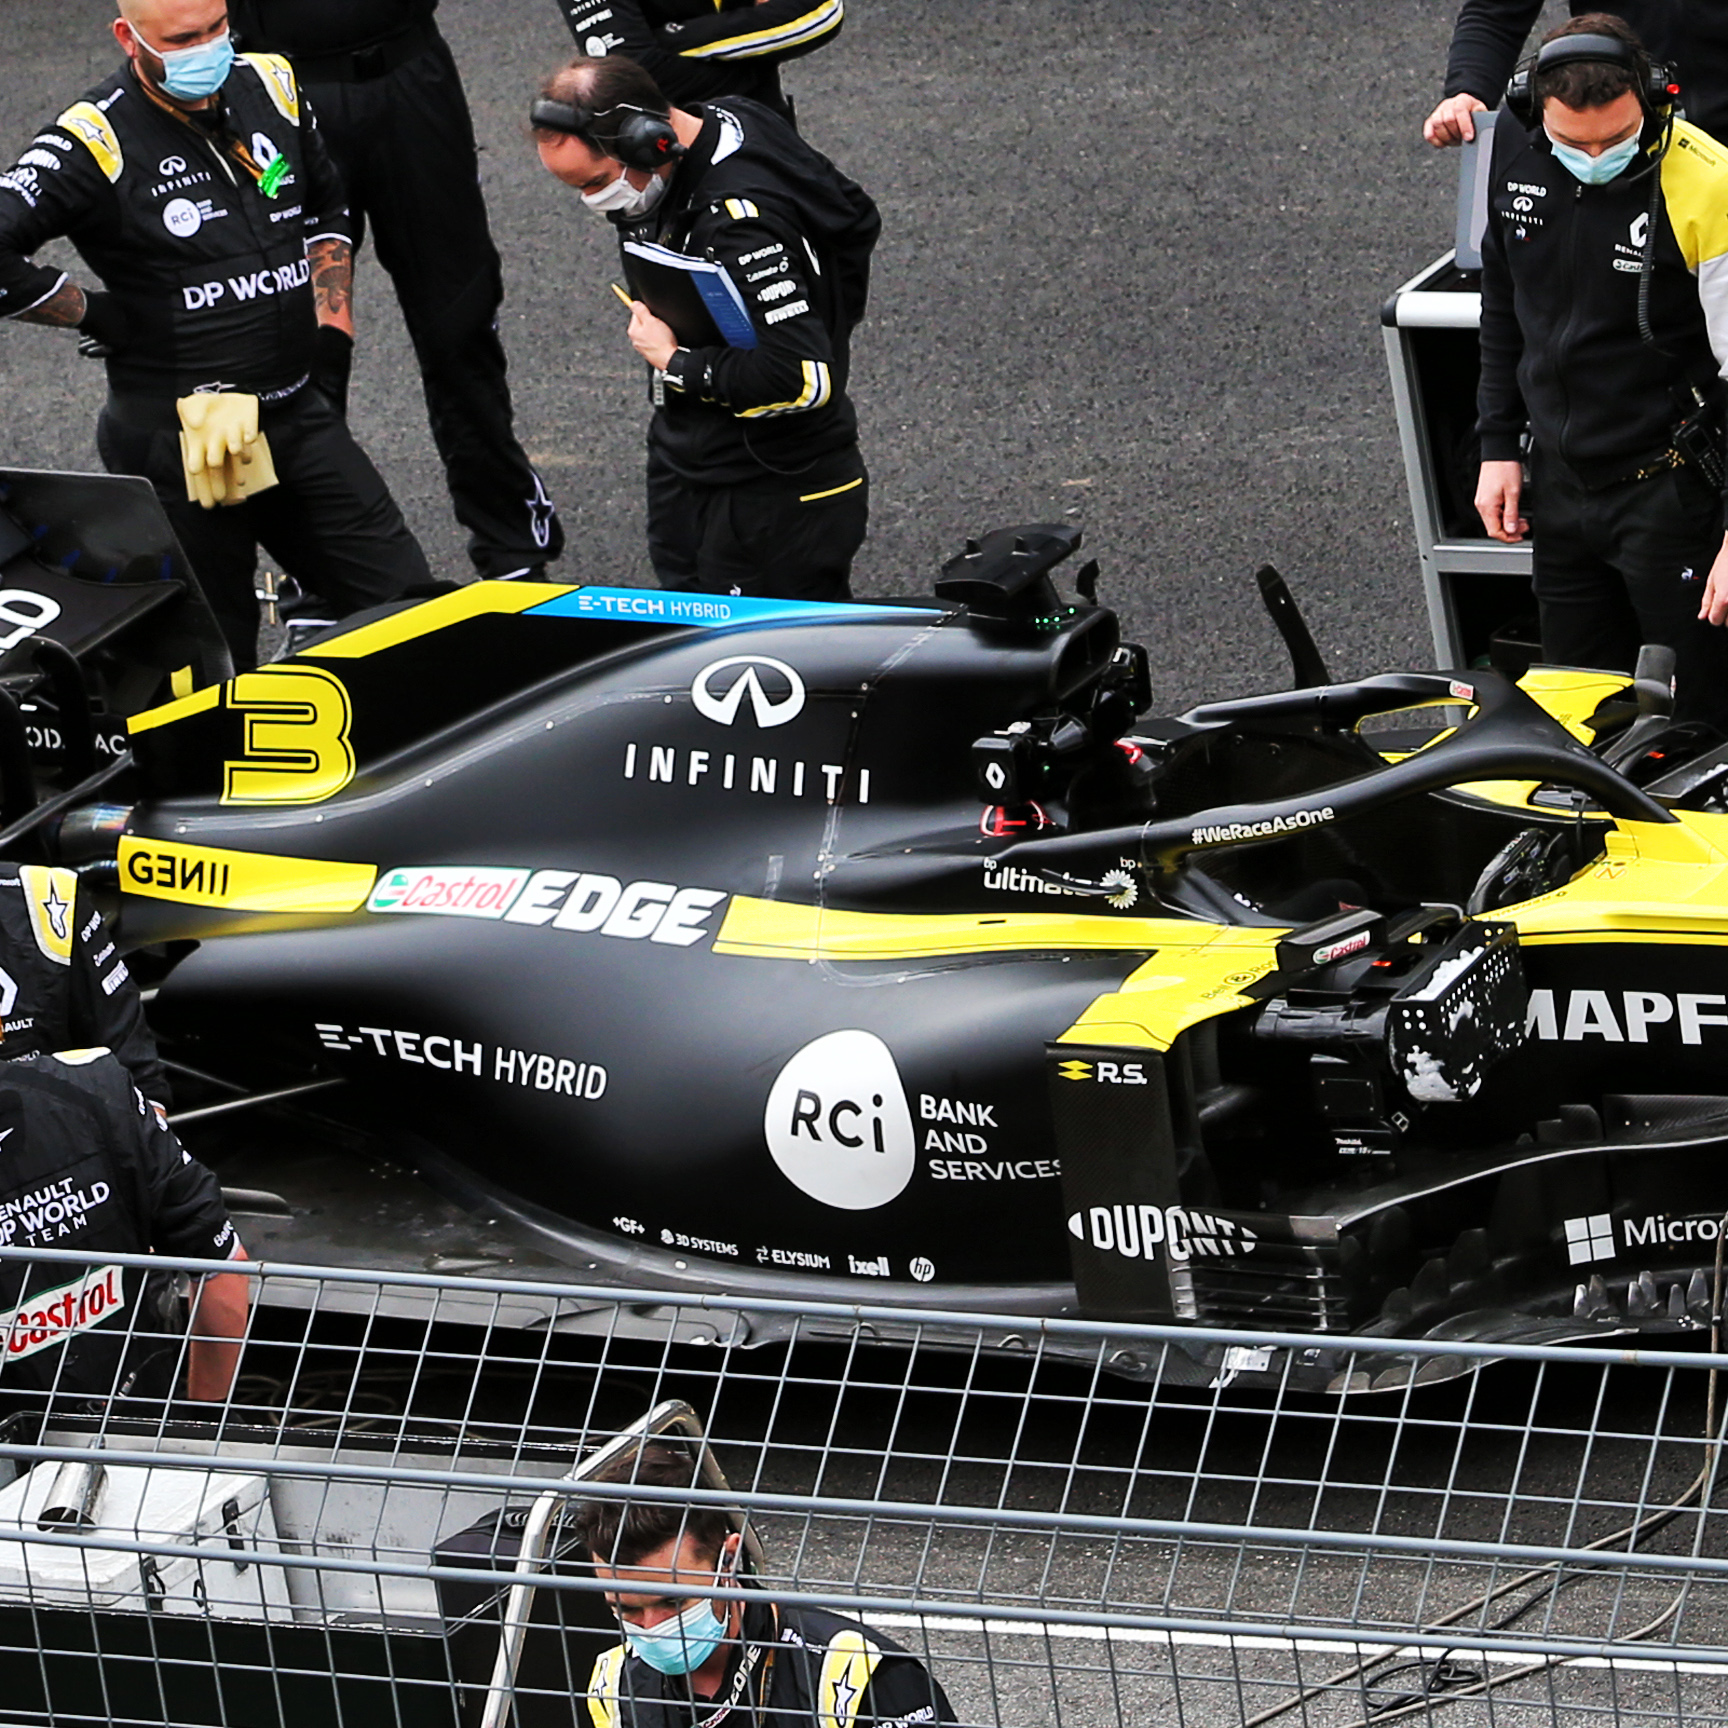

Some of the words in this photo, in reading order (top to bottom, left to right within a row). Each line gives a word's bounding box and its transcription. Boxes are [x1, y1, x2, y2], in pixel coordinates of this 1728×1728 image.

[151, 170, 213, 198] INFINITI
[1521, 183, 1548, 198] WORLD
[171, 208, 195, 227] RCi
[738, 253, 753, 267] DP
[752, 242, 784, 263] WORLD
[183, 281, 225, 310] DP
[227, 257, 311, 300] WORLD
[760, 280, 797, 303] DUPONT
[578, 595, 666, 617] E-TECH
[669, 600, 732, 622] HYBRID
[220, 662, 357, 807] 3
[624, 743, 870, 804] INFINITI
[1191, 806, 1335, 846] #WeRaceAsOne
[127, 849, 231, 898] GENII
[983, 856, 998, 871] bp
[1119, 857, 1137, 872] bp
[403, 872, 514, 914] Castrol
[503, 870, 728, 949] EDGE
[1328, 933, 1368, 962] Castrol
[1202, 983, 1230, 1002] Bell
[314, 1020, 484, 1078] E-TECH
[494, 1046, 608, 1103] HYBRID
[1096, 1061, 1148, 1086] R.S.
[919, 1093, 999, 1128] BANK
[925, 1130, 989, 1156] AND
[24, 1180, 112, 1234] WORLD
[25, 1213, 90, 1246] TEAM
[1090, 1204, 1240, 1264] DUPONT
[675, 1233, 690, 1247] 3D
[690, 1236, 740, 1257] SYSTEMS
[771, 1249, 832, 1270] ELYSIUM
[848, 1254, 891, 1277] ixell
[912, 1261, 933, 1282] hp
[7, 1270, 120, 1356] Castrol
